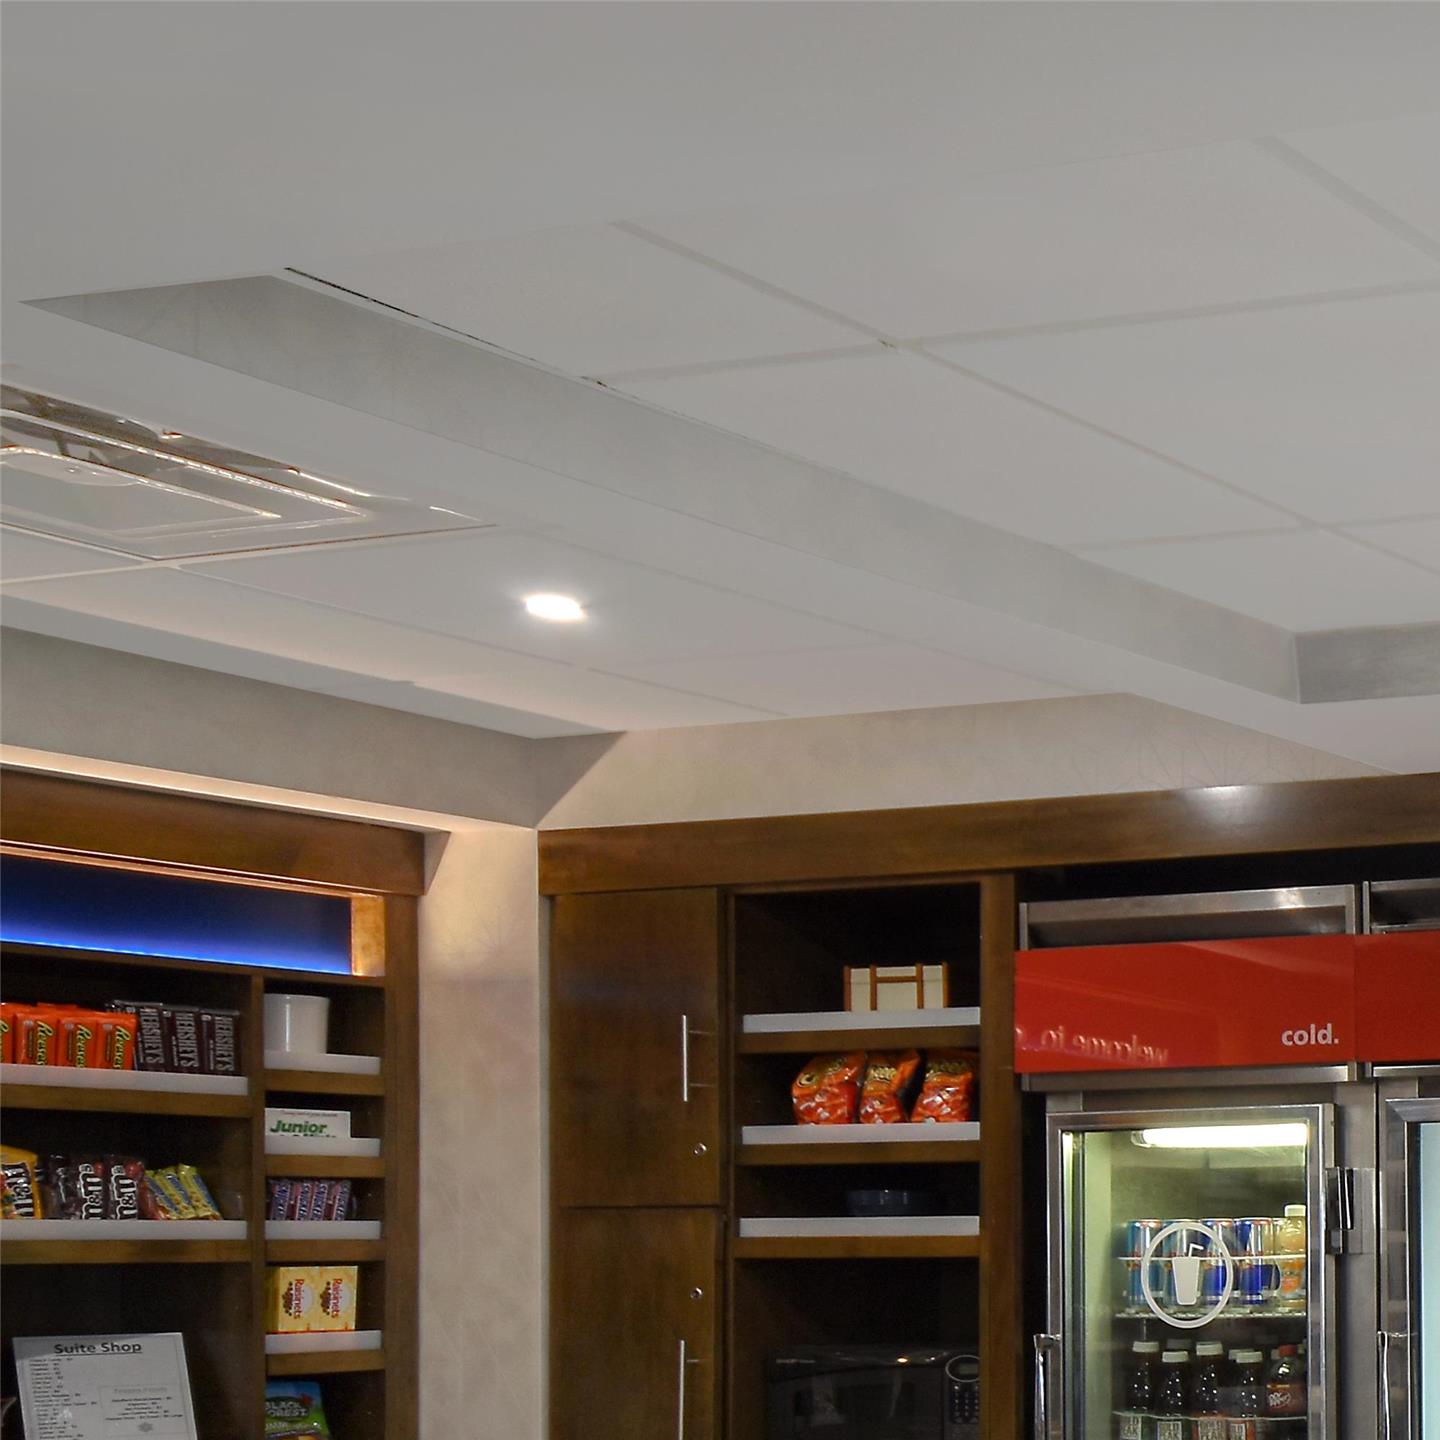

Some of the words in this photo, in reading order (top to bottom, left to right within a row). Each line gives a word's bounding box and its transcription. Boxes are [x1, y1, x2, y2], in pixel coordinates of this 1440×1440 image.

[1281, 1023, 1339, 1046] cold.
[270, 1120, 327, 1133] Junior
[54, 1343, 96, 1354] Suite
[100, 1342, 142, 1353] Shop
